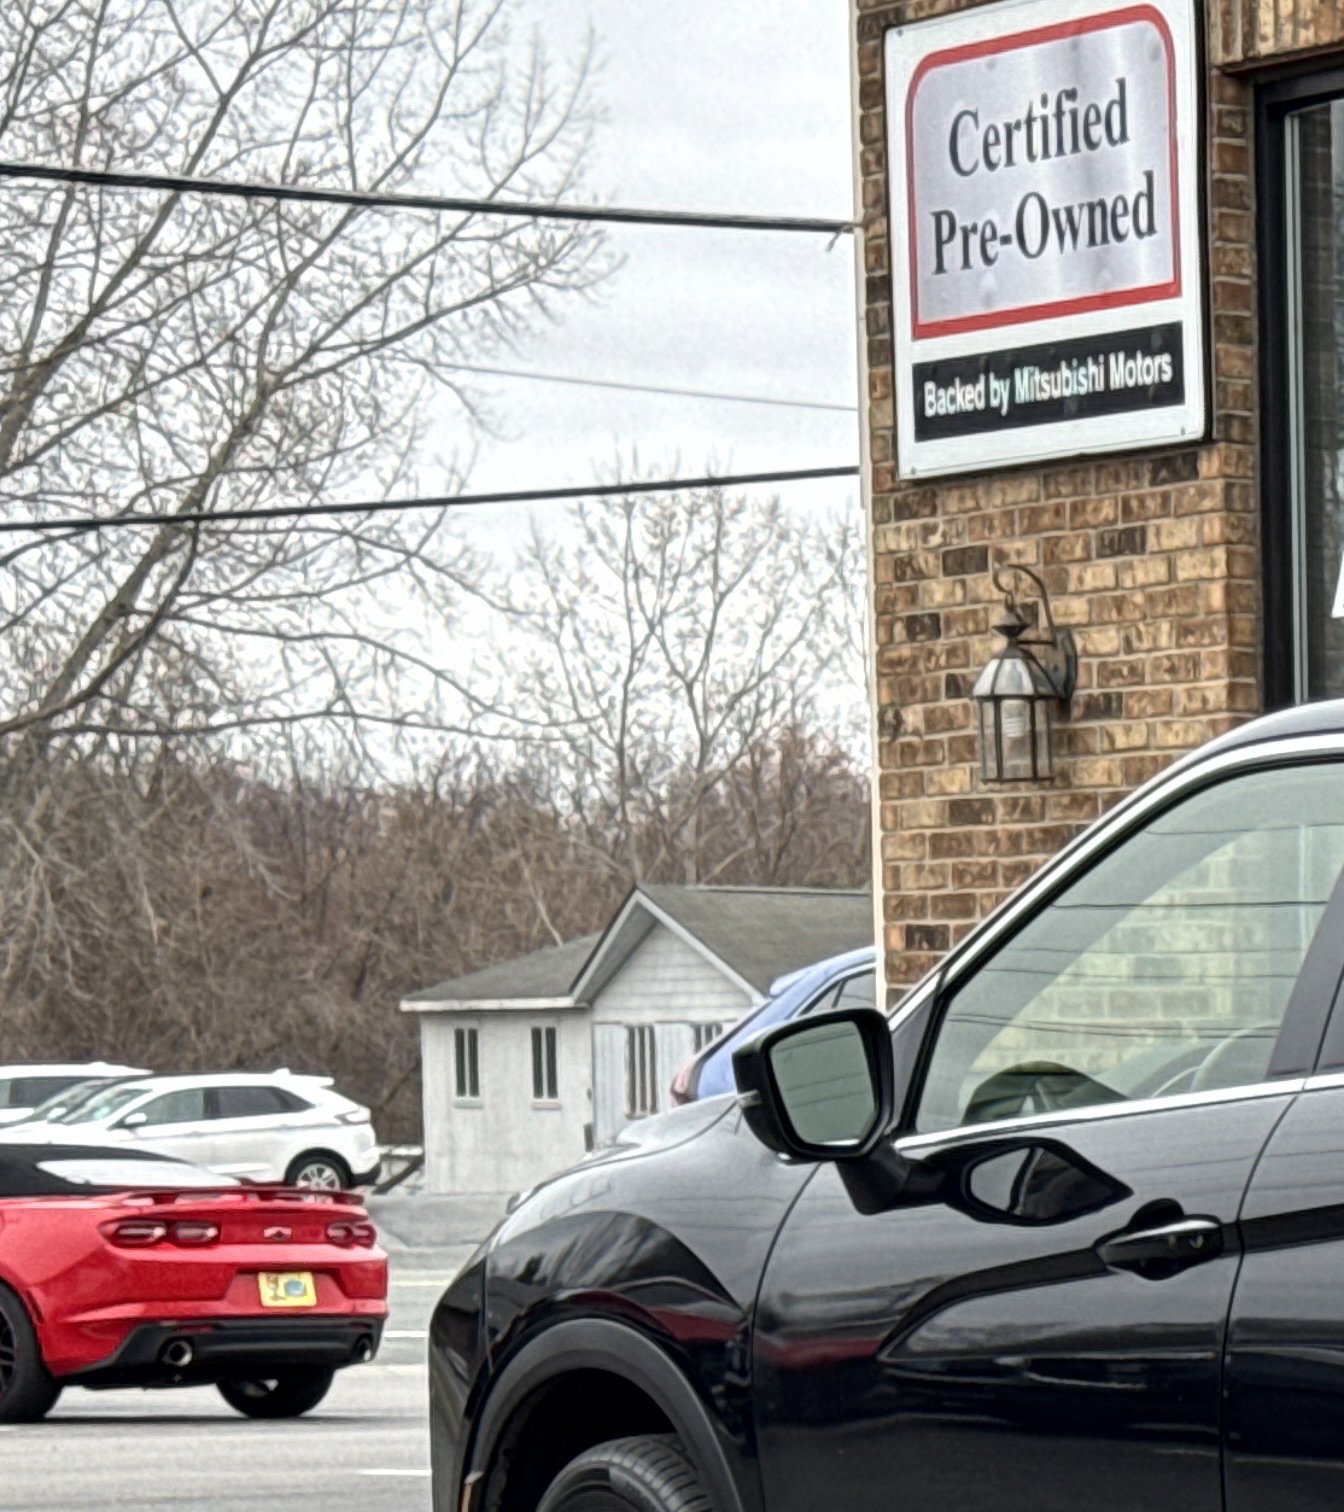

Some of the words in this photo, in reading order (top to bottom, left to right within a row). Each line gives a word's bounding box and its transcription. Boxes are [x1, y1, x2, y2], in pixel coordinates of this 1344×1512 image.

[949, 77, 1130, 177] Certified
[931, 169, 1158, 276] Pre-Owned
[923, 373, 985, 418] Backed
[989, 371, 1011, 416] by
[1014, 357, 1105, 404] Mitsubishi
[1109, 351, 1172, 389] Motors
